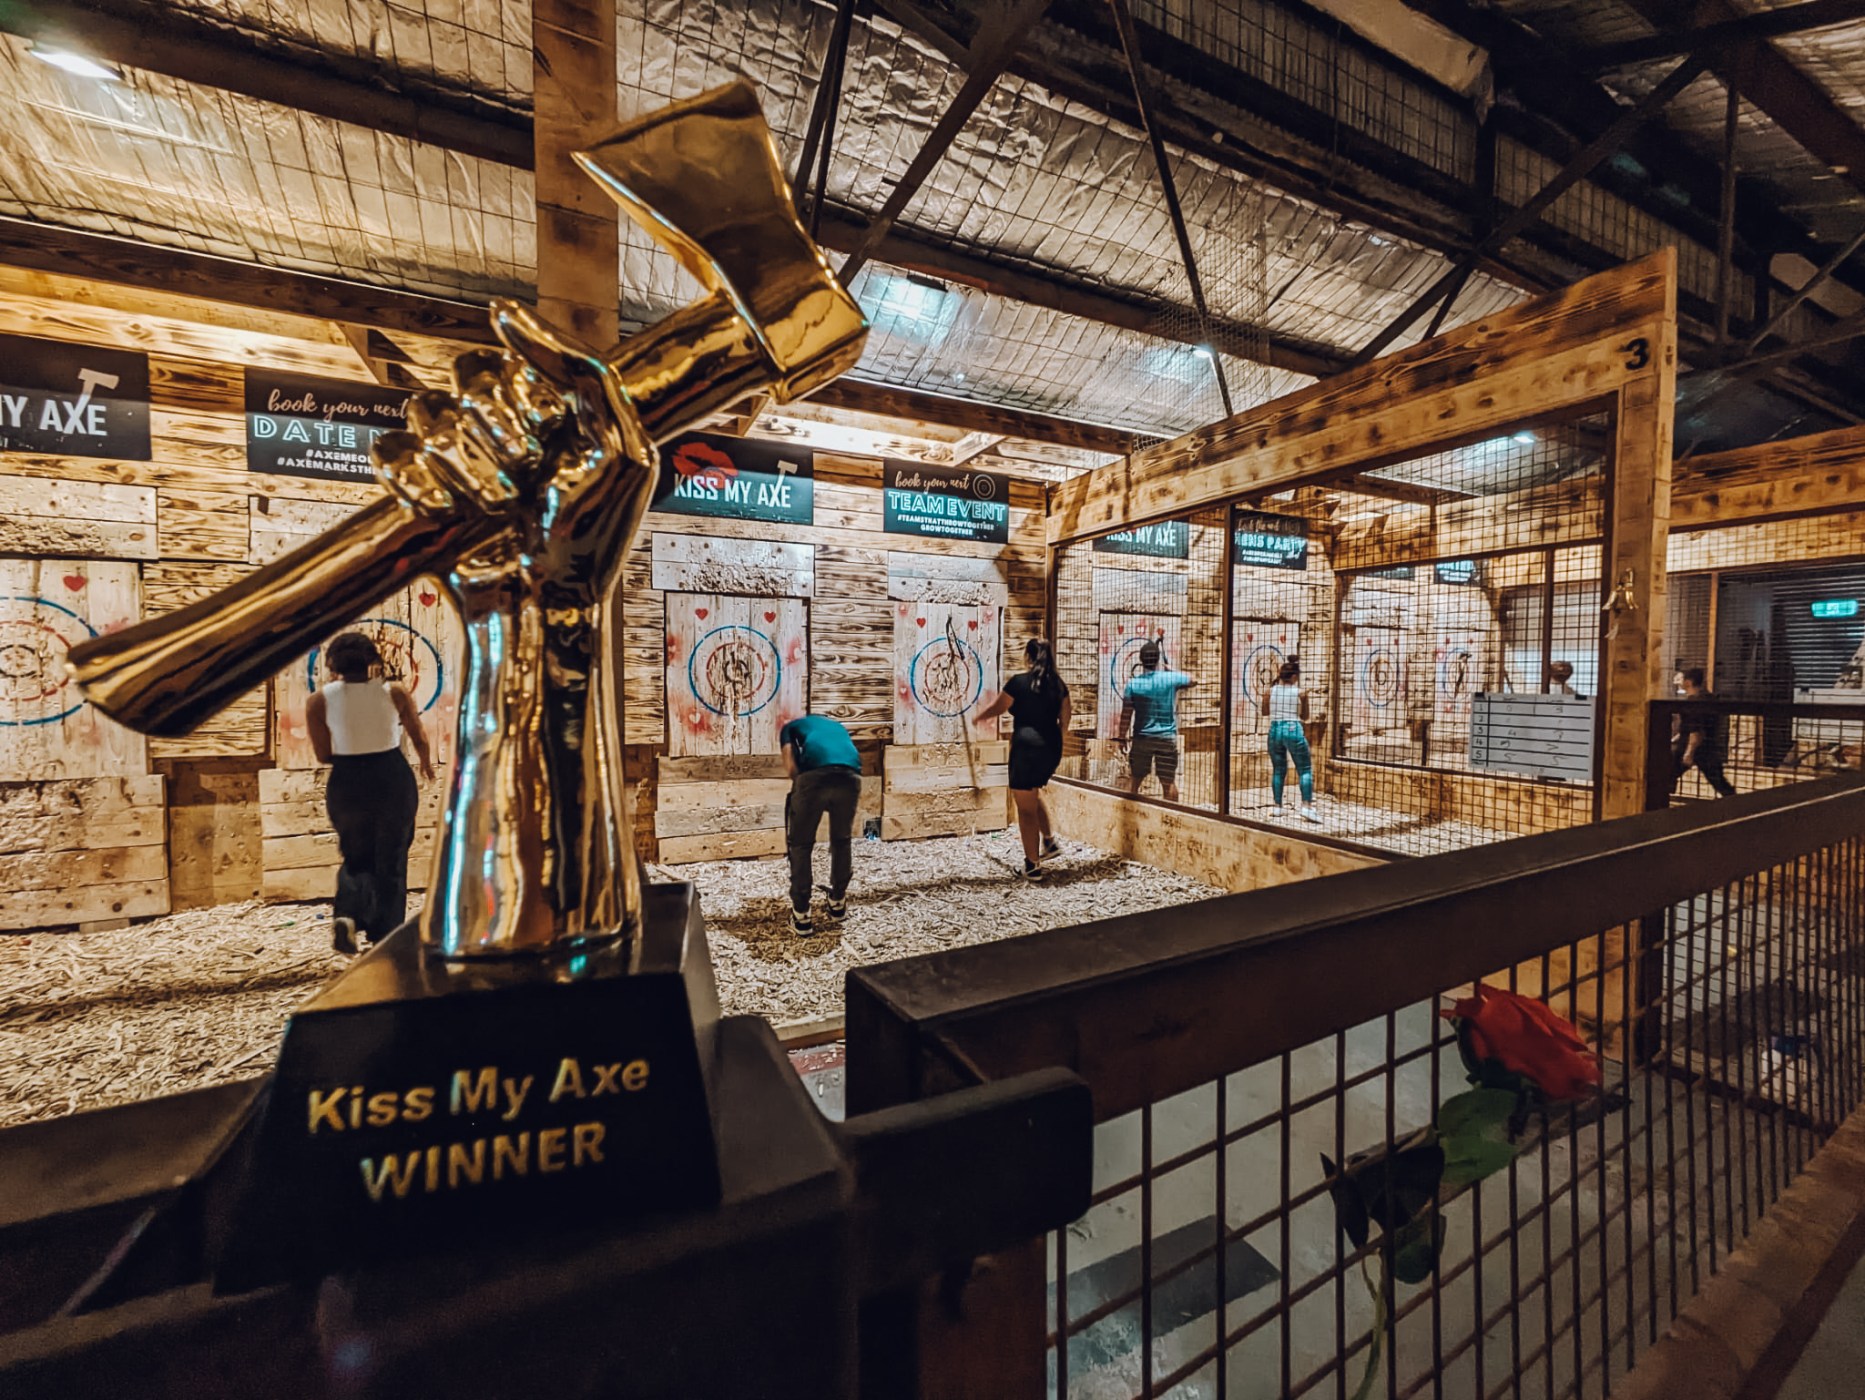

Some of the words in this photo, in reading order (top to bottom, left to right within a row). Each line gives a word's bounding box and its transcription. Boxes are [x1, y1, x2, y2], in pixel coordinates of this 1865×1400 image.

[1625, 338, 1650, 370] 3
[0, 394, 28, 428] Y
[39, 387, 113, 436] AXE
[268, 388, 317, 413] book
[323, 401, 369, 423] your
[373, 399, 409, 419] next
[253, 414, 357, 448] DATE
[674, 473, 719, 501] KISS
[724, 479, 752, 503] MY
[757, 471, 794, 508] AXE
[895, 471, 921, 488] book
[923, 479, 948, 495] your
[949, 473, 970, 491] next
[888, 491, 944, 515] TEAM
[947, 498, 1005, 521] EVENT
[1136, 526, 1154, 544] MY
[1155, 521, 1177, 546] AXE
[309, 1085, 436, 1134] Kiss
[449, 1066, 536, 1122] My
[549, 1057, 651, 1103] Axe
[360, 1121, 607, 1202] WINNER
